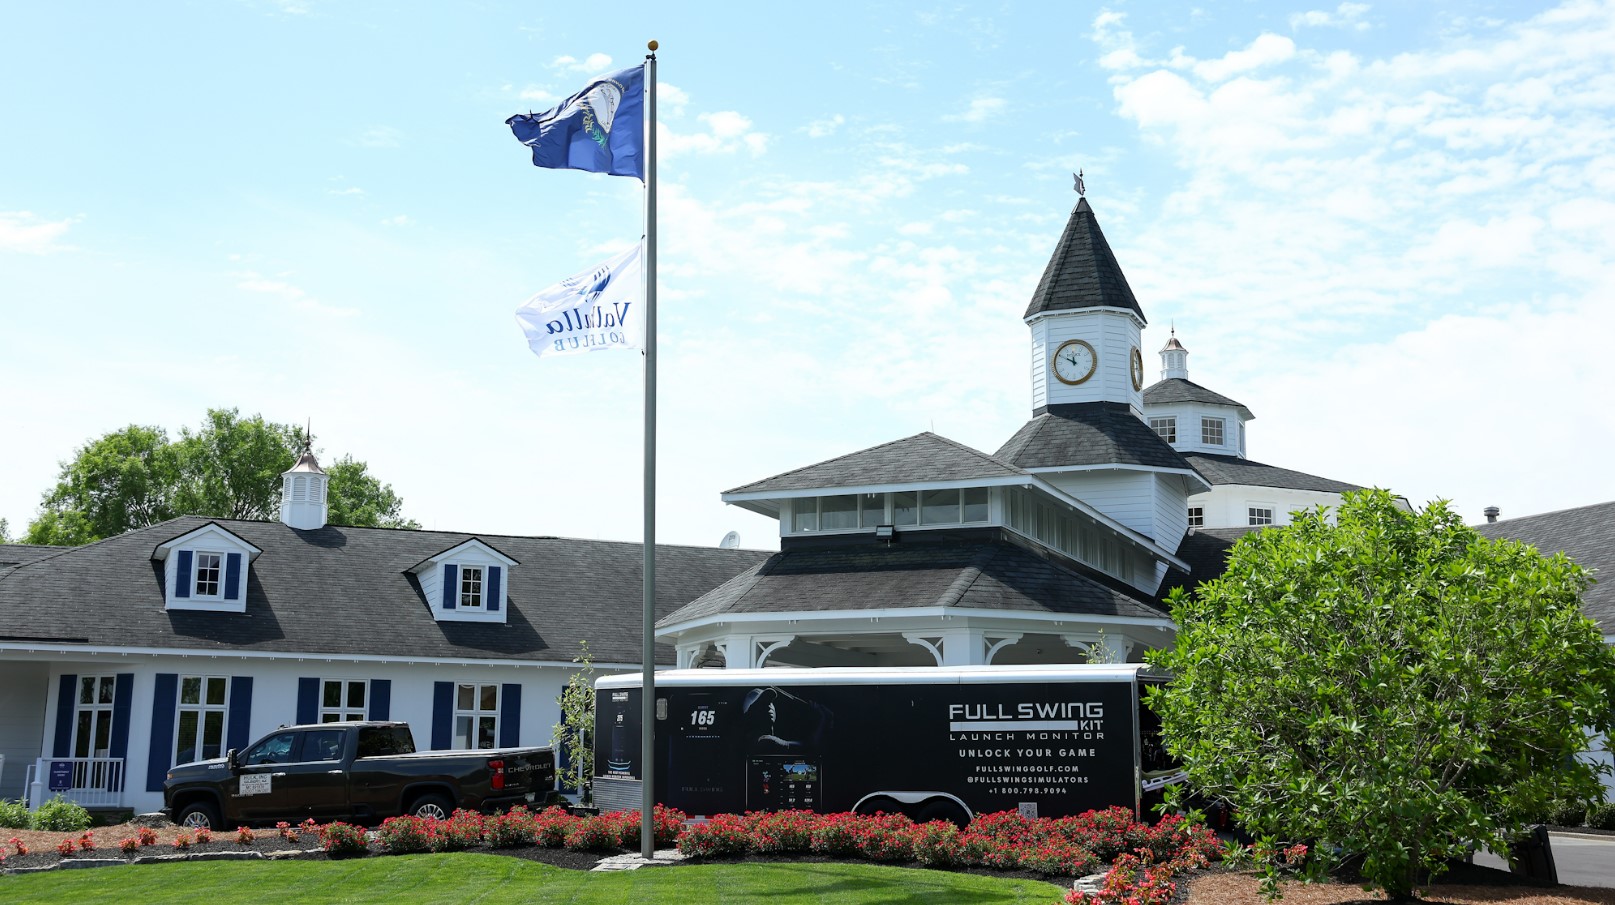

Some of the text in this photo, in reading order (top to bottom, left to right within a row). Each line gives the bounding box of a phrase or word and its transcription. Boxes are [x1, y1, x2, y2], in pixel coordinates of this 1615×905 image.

[949, 702, 1104, 720] FULL SWING
[690, 710, 716, 726] 165
[1080, 719, 1104, 731] KIT
[949, 732, 1105, 741] LAUNCH MONITOR
[958, 747, 1096, 758] UNLOCK YOUR GAME
[508, 762, 551, 773] CHEVROLET
[975, 765, 1079, 773] FULLSWINGGOLF.COM
[966, 776, 1089, 784] @FULLSWINGSIMULATORS
[1001, 786, 1067, 795] 800.798.9094
